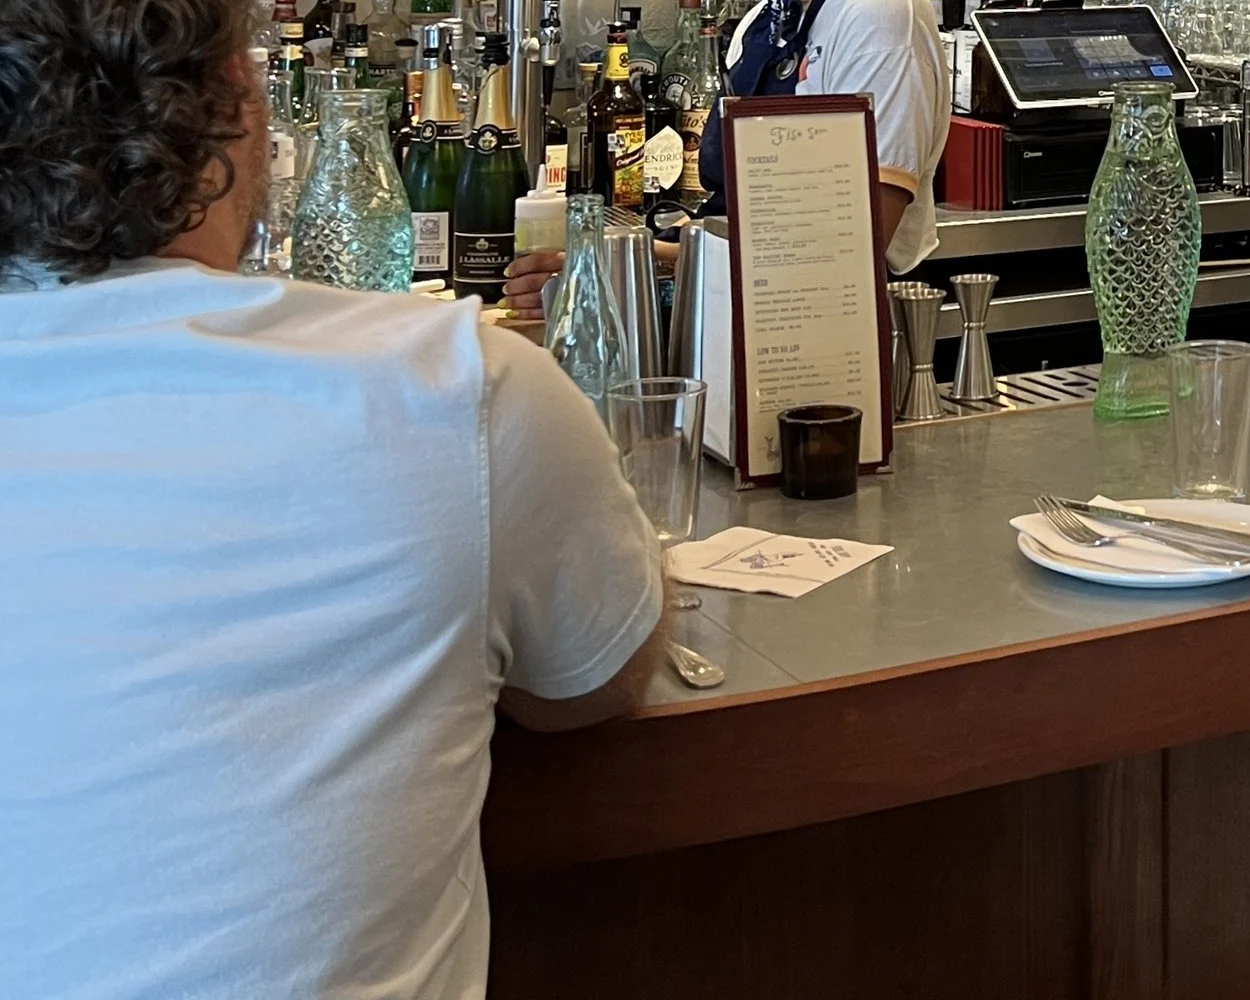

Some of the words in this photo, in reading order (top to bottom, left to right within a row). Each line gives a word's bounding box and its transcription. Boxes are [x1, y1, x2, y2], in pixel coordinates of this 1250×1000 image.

[681, 115, 707, 128] ito's
[645, 152, 683, 162] ENDRIC
[545, 167, 566, 184] ING
